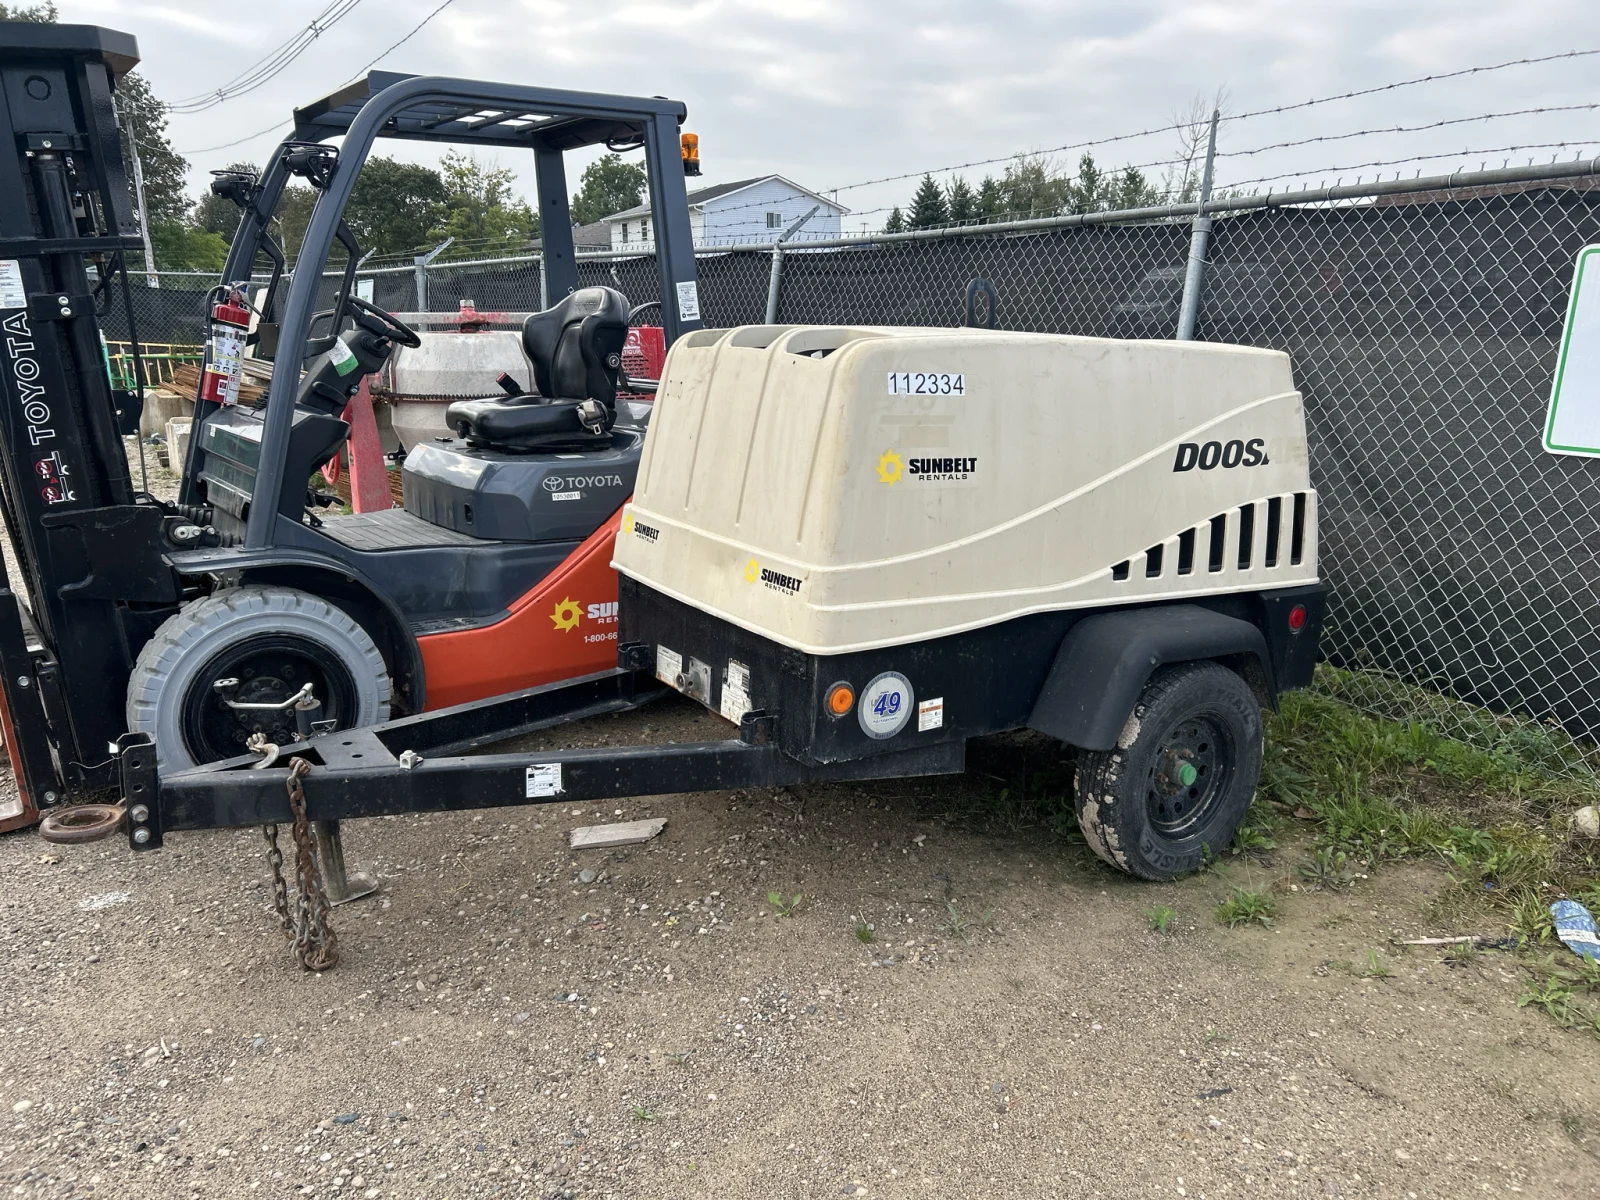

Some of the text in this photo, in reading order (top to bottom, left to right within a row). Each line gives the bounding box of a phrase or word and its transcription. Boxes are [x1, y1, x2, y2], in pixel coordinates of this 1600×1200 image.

[3, 311, 56, 446] TOYOTA
[889, 372, 964, 395] 112334
[909, 457, 978, 474] SUNBELT
[566, 474, 623, 489] TOYOTA
[918, 473, 968, 482] RENTALS
[634, 521, 660, 541] SUNBELT
[760, 568, 803, 593] SUNBELT
[764, 582, 794, 597] RENTALS
[873, 691, 901, 716] 49
